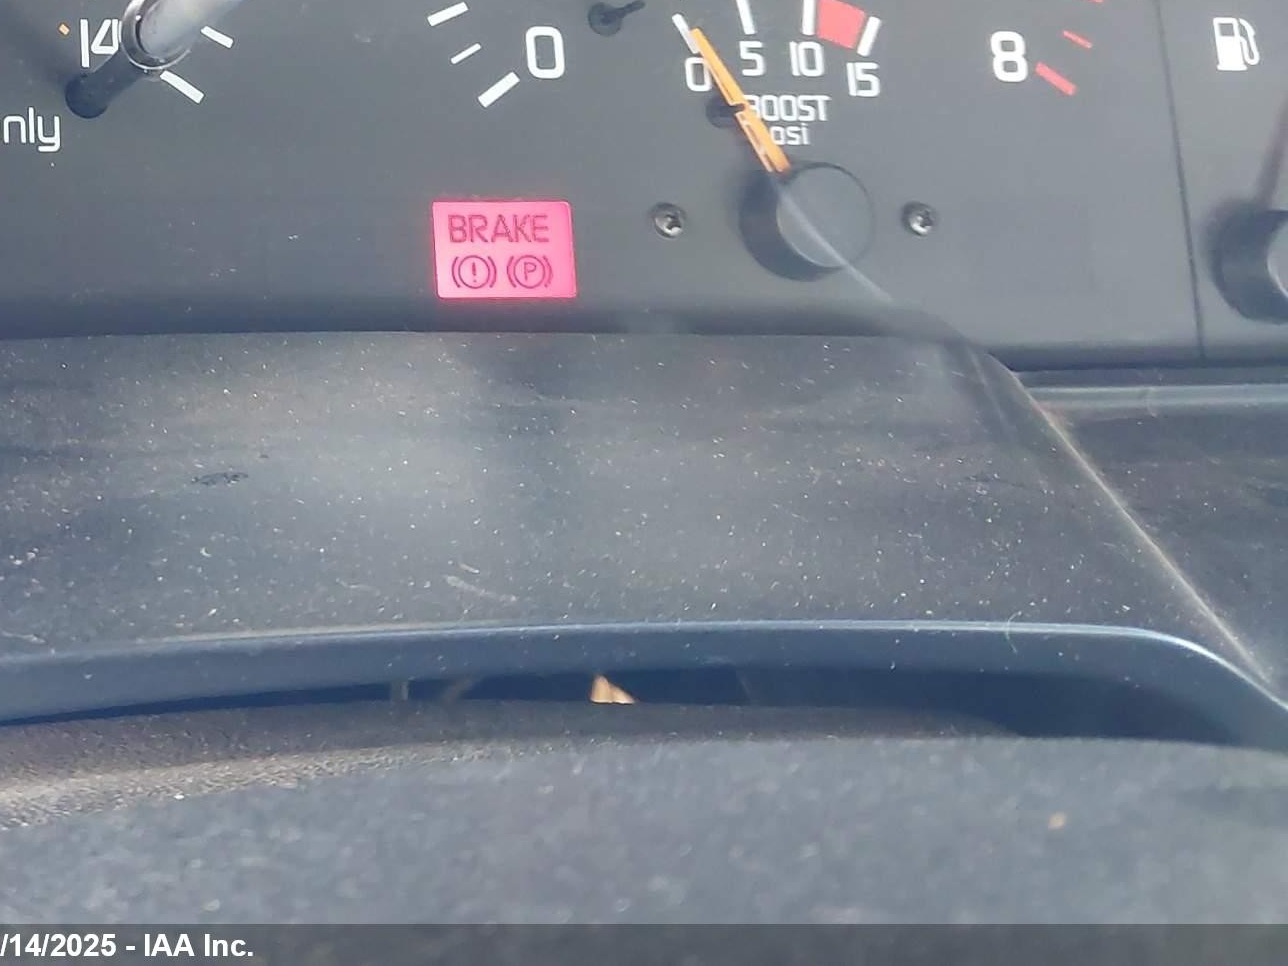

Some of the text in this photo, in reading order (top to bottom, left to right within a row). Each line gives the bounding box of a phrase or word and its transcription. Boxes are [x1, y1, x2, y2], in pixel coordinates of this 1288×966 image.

[79, 18, 123, 68] 14
[525, 26, 565, 79] 0
[739, 40, 765, 77] 5
[789, 41, 825, 77] 10
[990, 30, 1028, 83] 8
[685, 57, 711, 92] 0
[846, 62, 881, 97] 15
[448, 214, 550, 243] BRAKE
